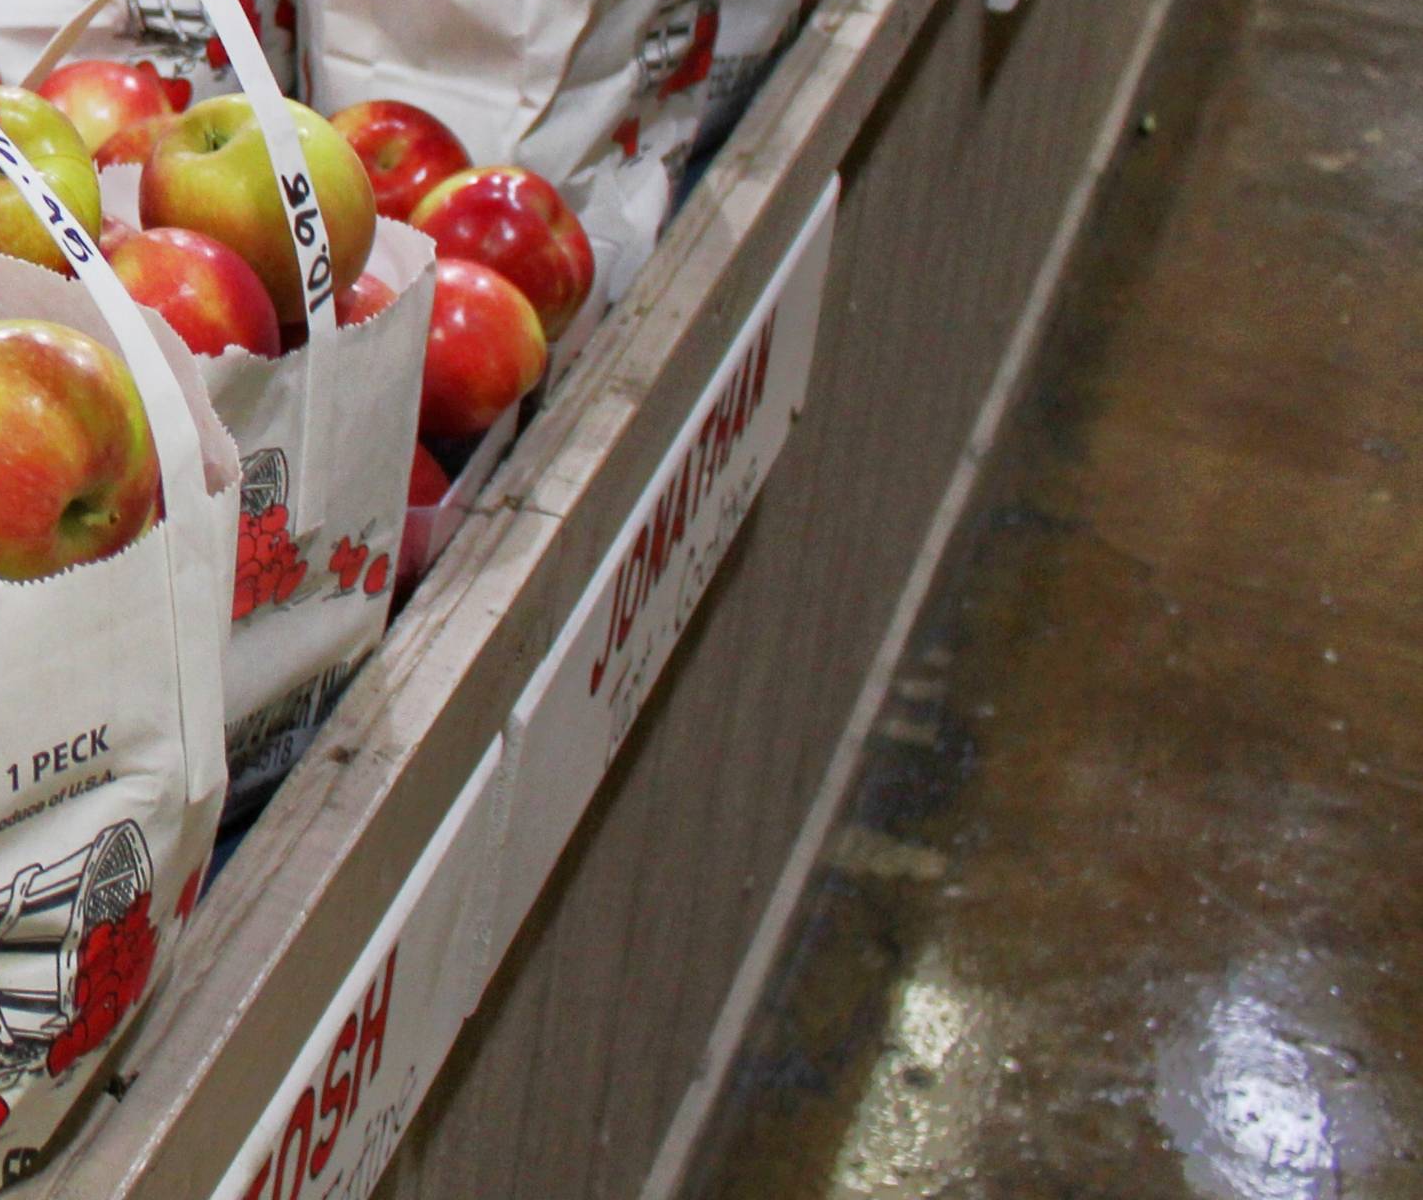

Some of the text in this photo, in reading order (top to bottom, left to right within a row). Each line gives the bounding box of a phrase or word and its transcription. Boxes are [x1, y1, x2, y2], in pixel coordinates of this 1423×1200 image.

[280, 171, 333, 314] 10.95
[589, 304, 777, 697] JONATHAN
[6, 723, 111, 793] 1 PECK
[48, 786, 67, 808] of
